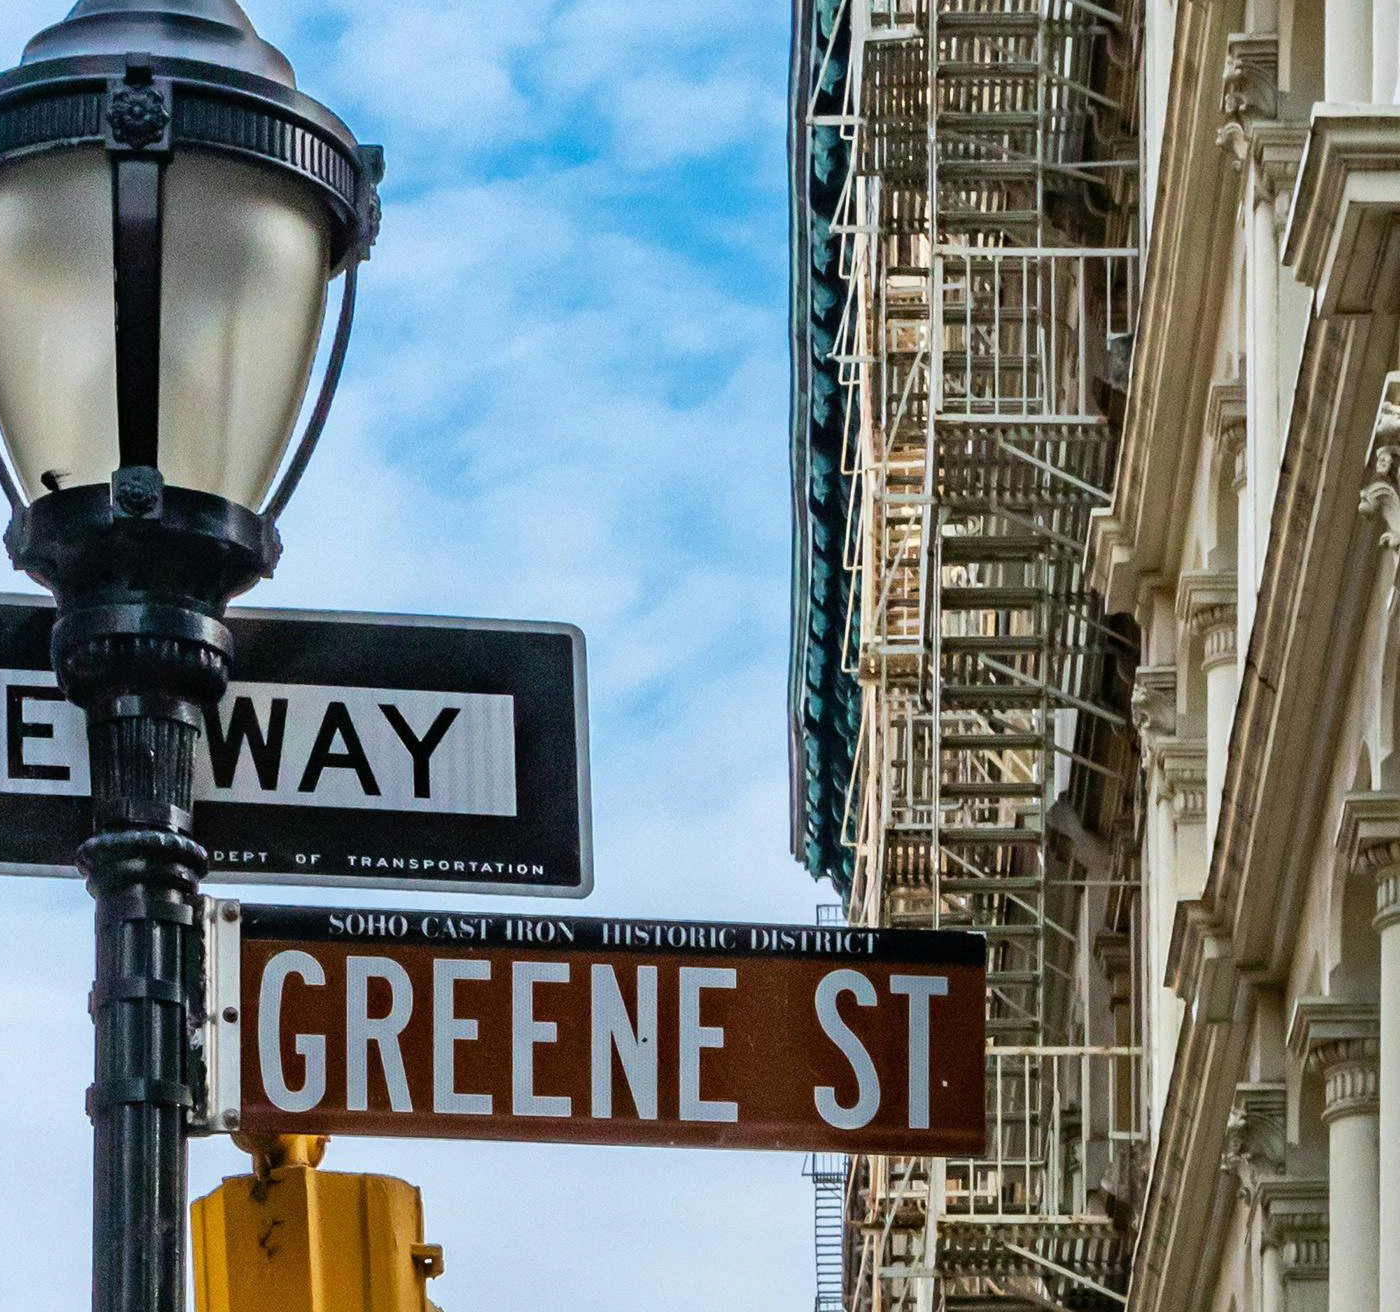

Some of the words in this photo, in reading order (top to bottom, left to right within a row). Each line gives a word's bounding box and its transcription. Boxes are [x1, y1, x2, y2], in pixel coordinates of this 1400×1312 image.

[201, 696, 462, 798] WAY
[213, 850, 268, 863] DEPT
[295, 853, 321, 865] OF
[347, 855, 545, 875] TRANSPORTATION
[328, 914, 408, 936] SOHO
[421, 916, 493, 939] CAST
[505, 918, 574, 942] IRON
[602, 923, 737, 948] HISTORIC
[750, 928, 881, 954] DISTRICT
[257, 949, 739, 1123] GREENE
[813, 968, 949, 1130] ST
